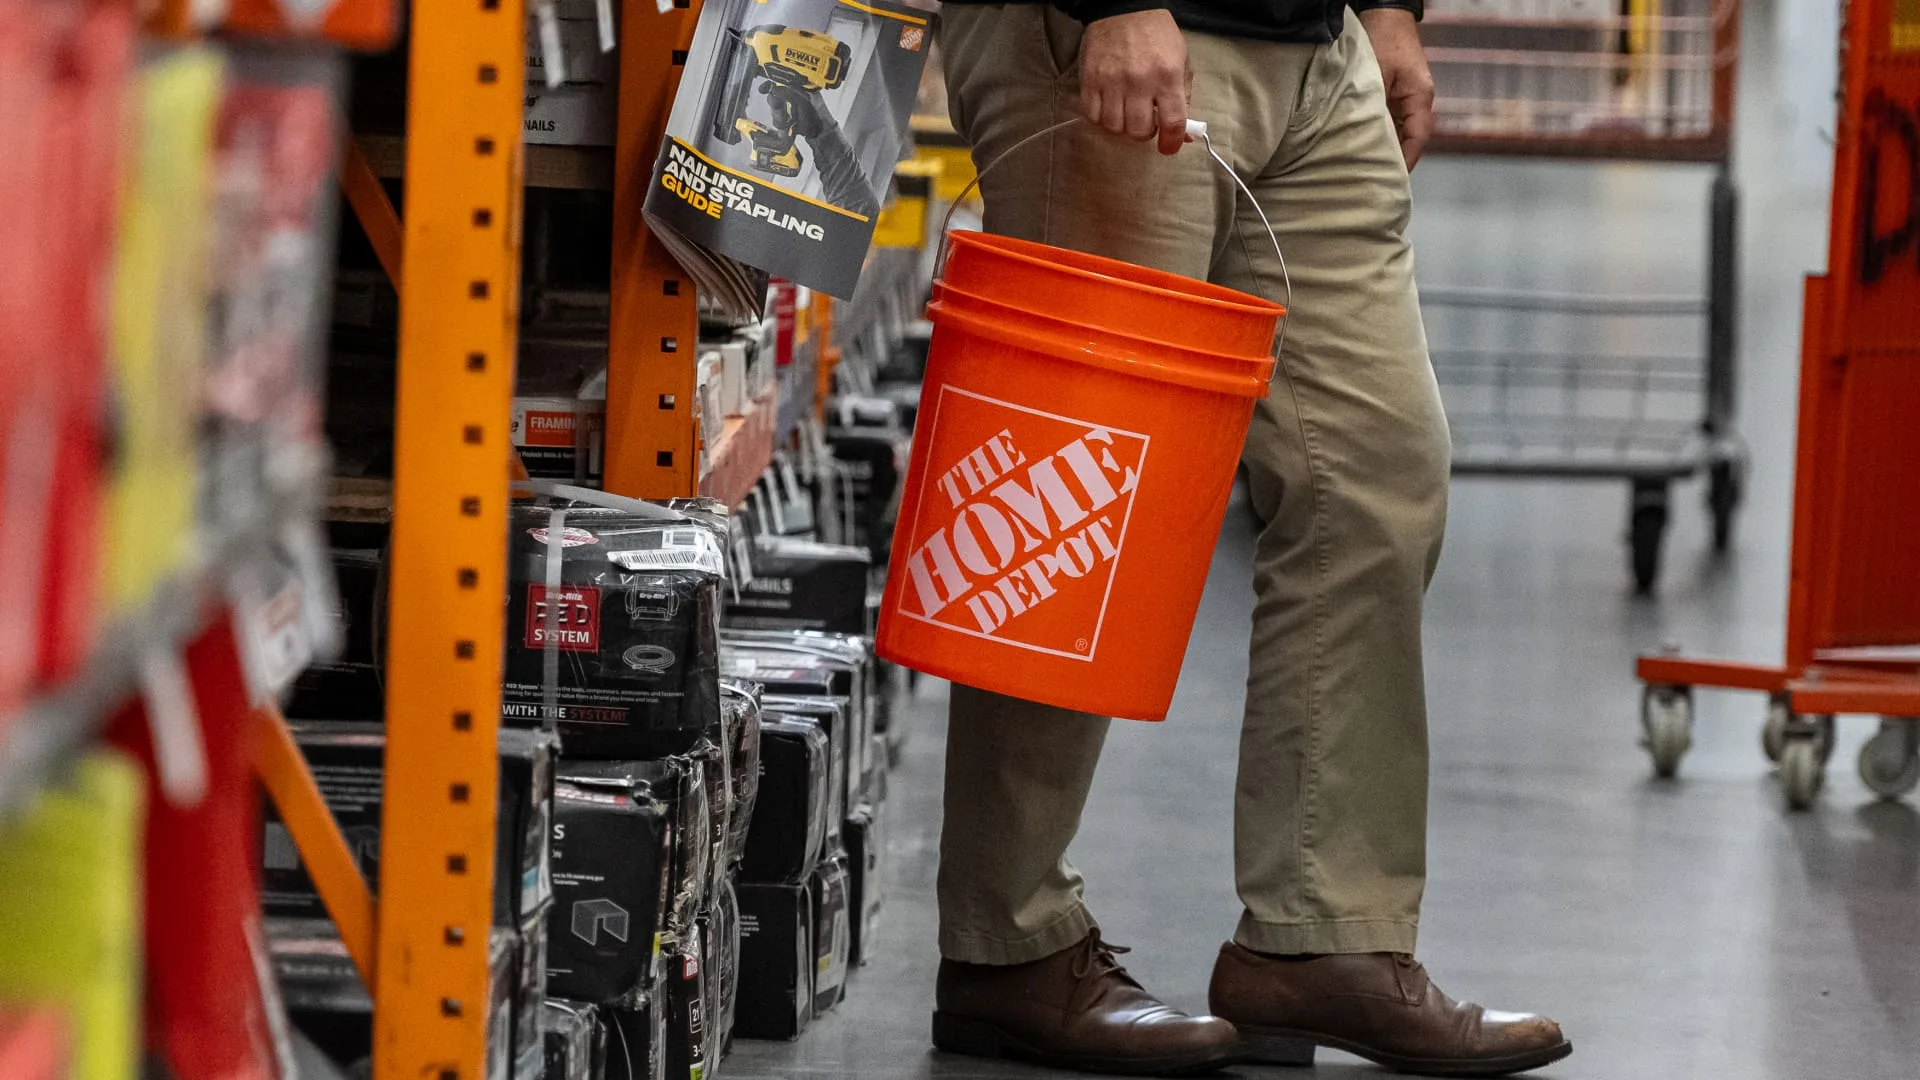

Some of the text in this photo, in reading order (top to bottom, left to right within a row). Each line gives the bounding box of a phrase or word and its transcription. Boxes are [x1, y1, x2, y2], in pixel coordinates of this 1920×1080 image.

[524, 119, 555, 132] NAILS
[661, 173, 723, 219] GUIDE
[669, 145, 754, 200] NAILING
[664, 161, 824, 241] AND STAPLING
[530, 416, 577, 430] FRAMIN
[936, 428, 1027, 509] THE
[907, 428, 1138, 619] HOME
[965, 515, 1117, 635] DEPOT
[534, 629, 589, 643] SYSTEM
[502, 704, 627, 721] WITH THE SYSTEM!
